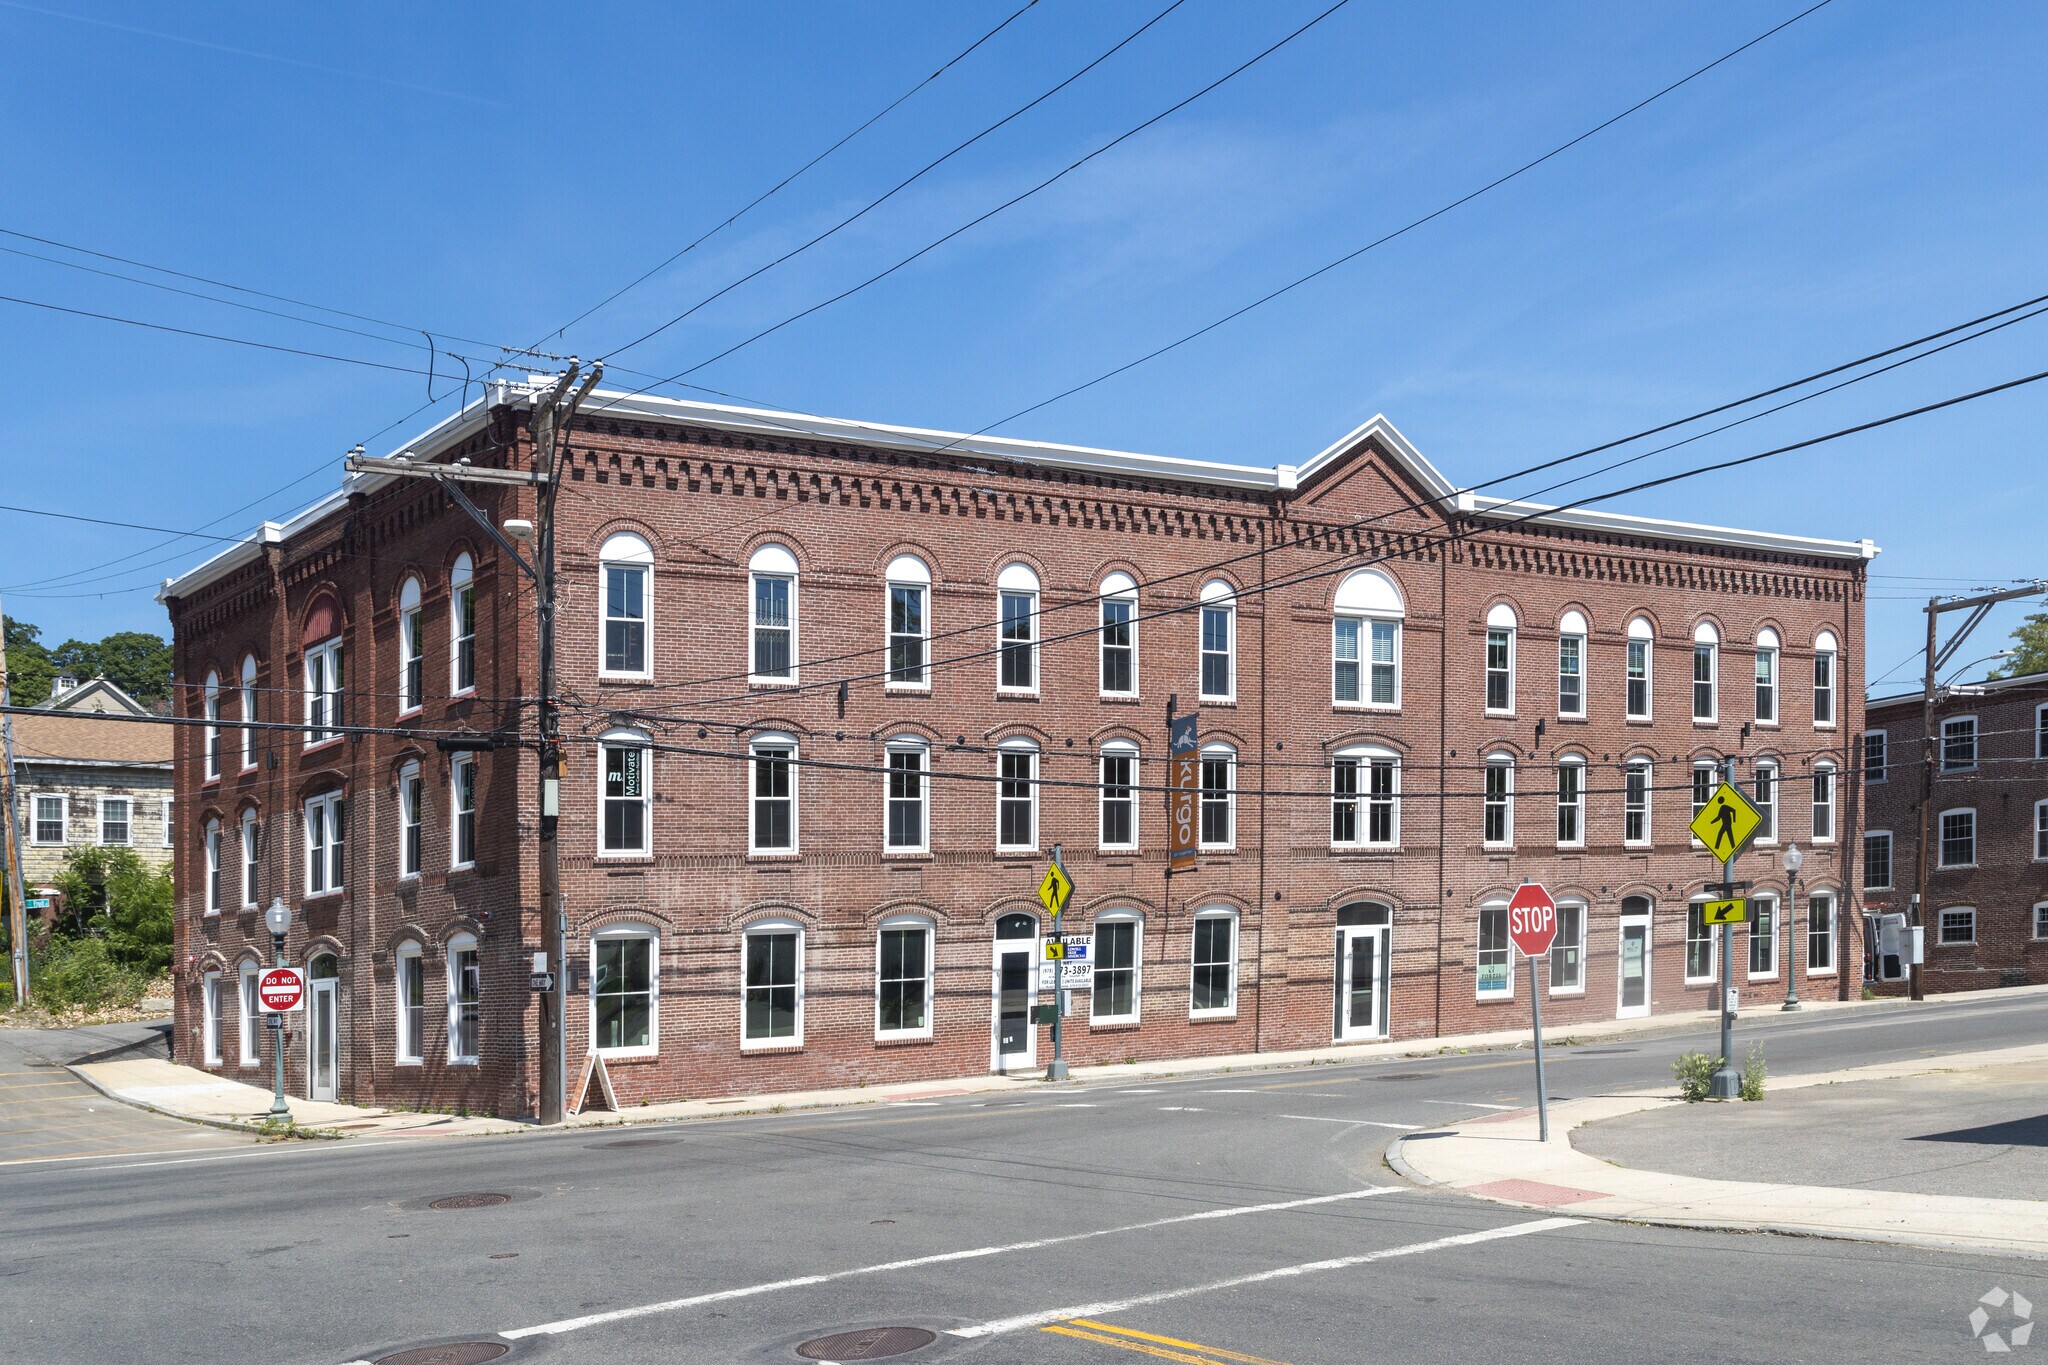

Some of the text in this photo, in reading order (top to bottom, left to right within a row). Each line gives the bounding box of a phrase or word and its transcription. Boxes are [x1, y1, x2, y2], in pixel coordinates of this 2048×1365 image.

[626, 751, 635, 796] Motivate
[1176, 757, 1192, 845] kurgo
[1512, 906, 1553, 934] STOP
[1046, 937, 1091, 945] AILABLE
[1054, 965, 1091, 975] 73-3897
[281, 976, 297, 984] NOT
[269, 995, 294, 1003] ENTER
